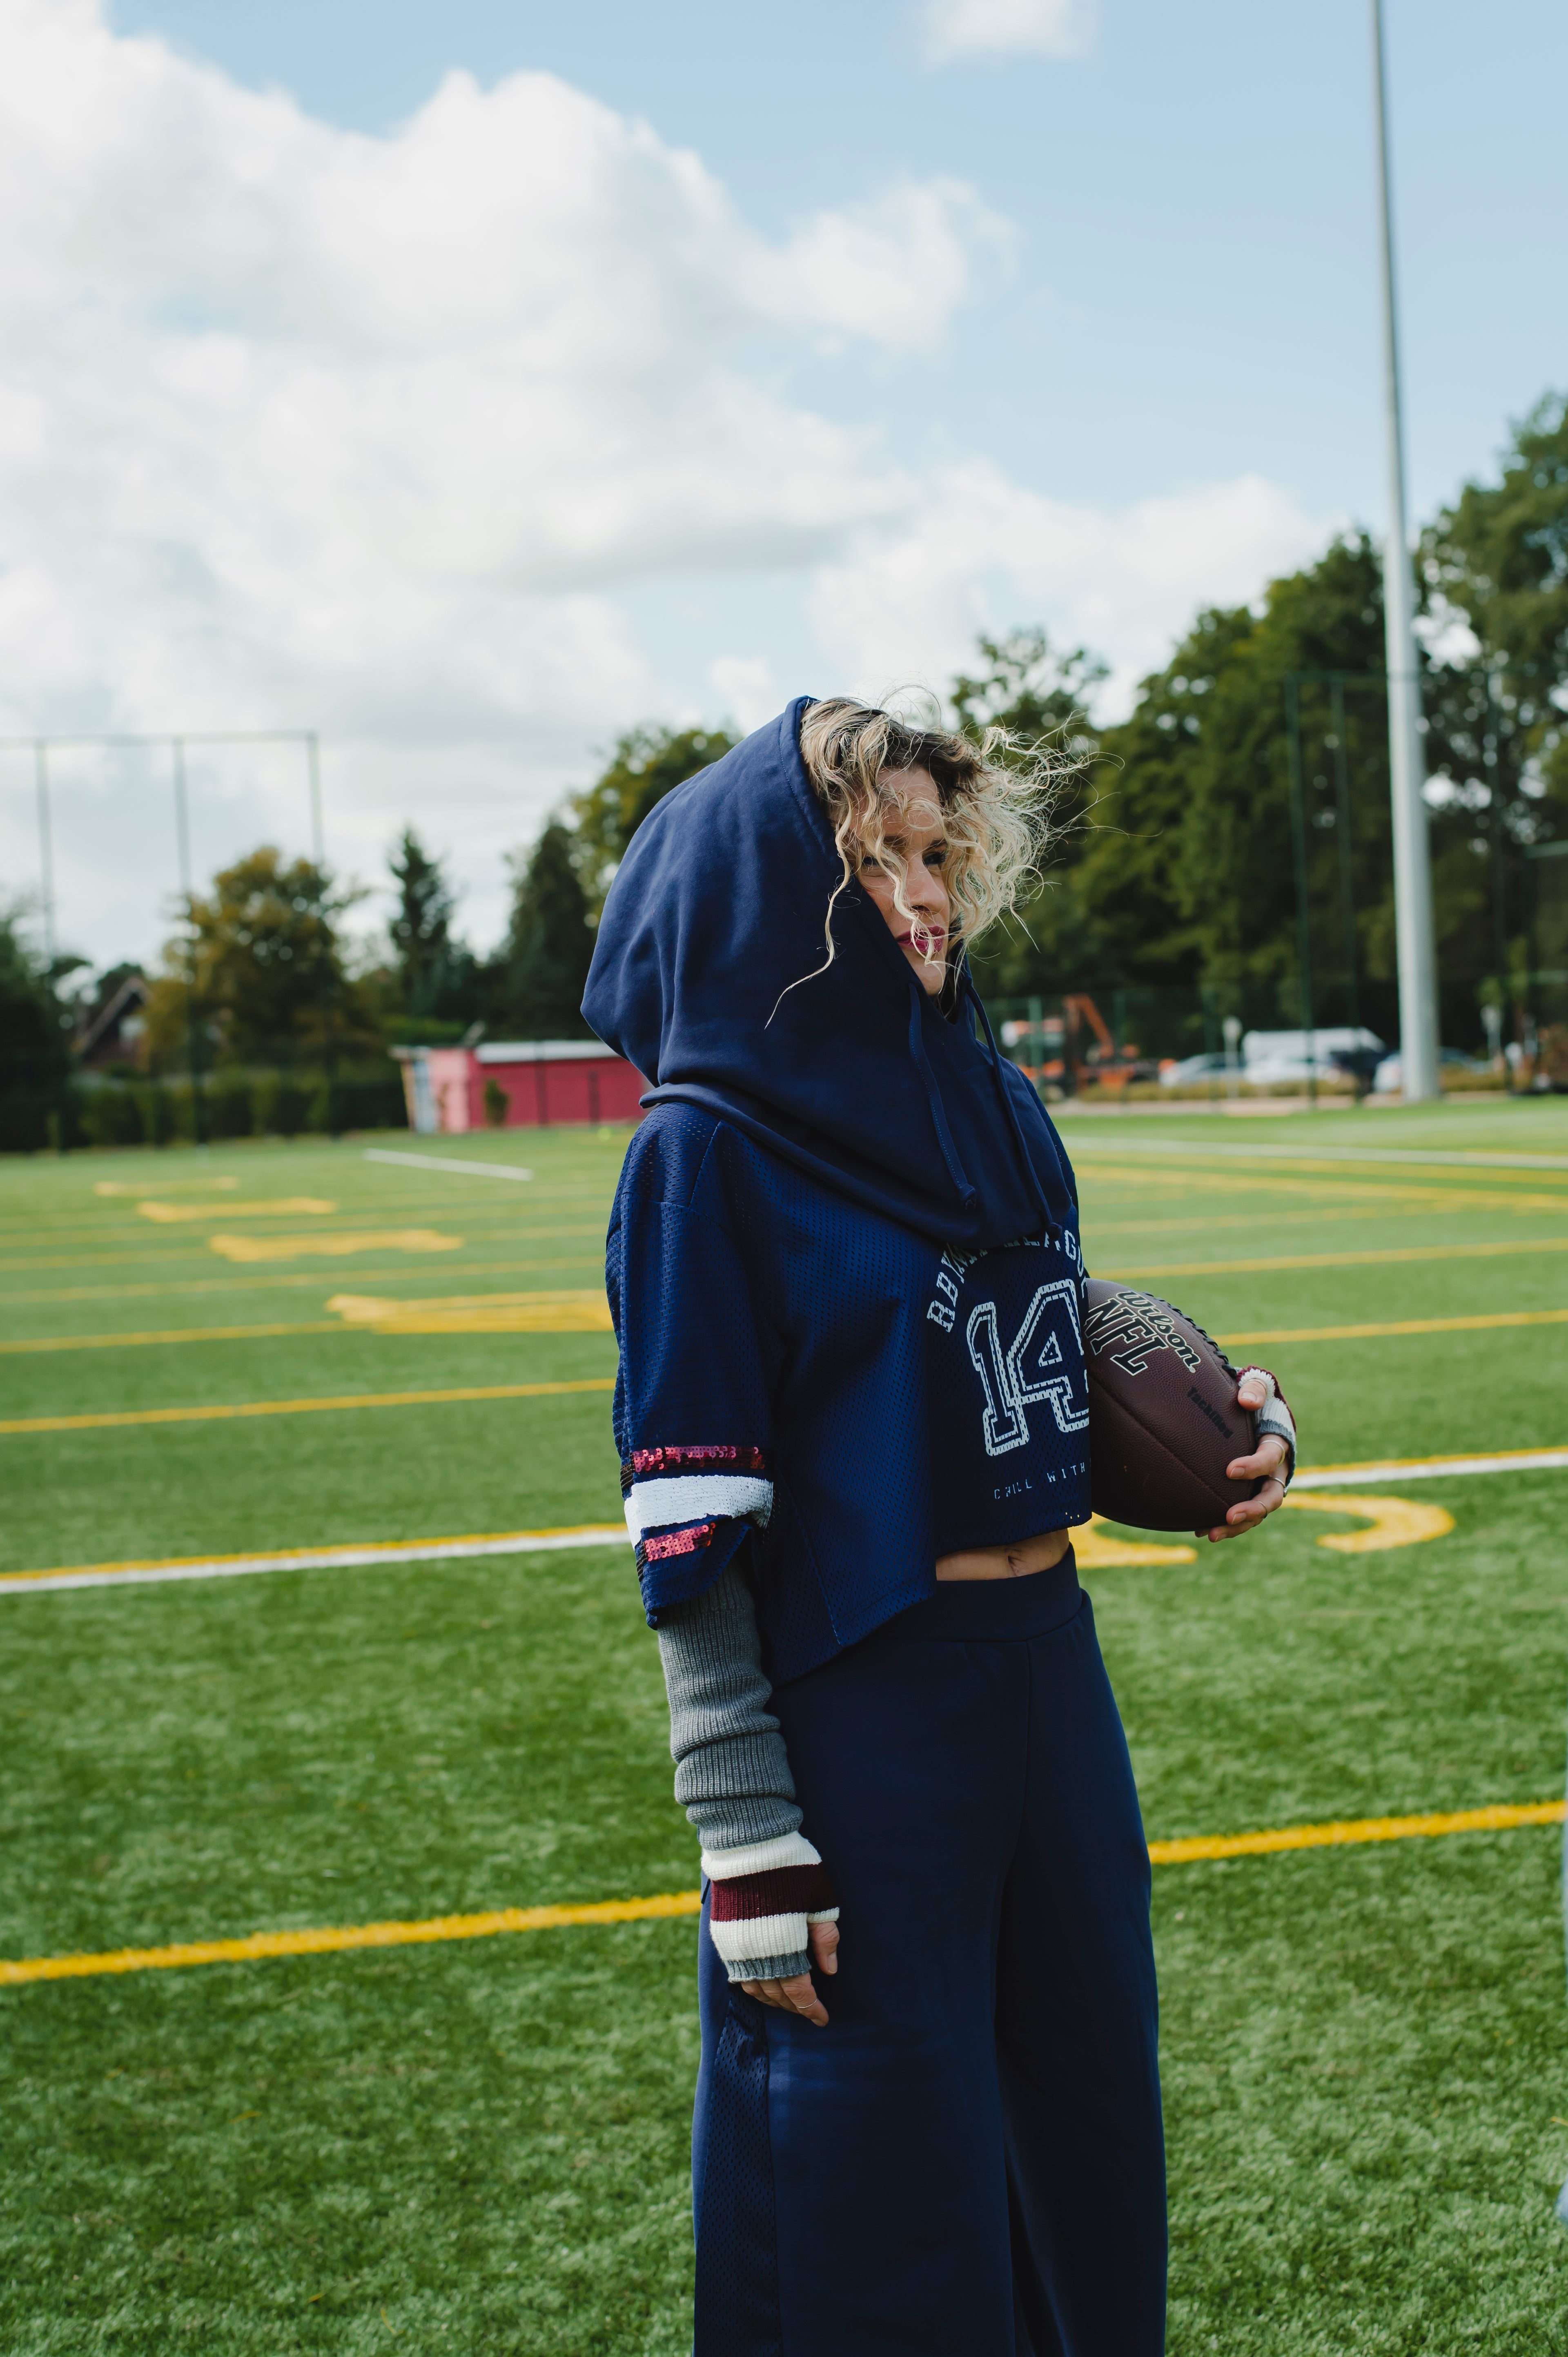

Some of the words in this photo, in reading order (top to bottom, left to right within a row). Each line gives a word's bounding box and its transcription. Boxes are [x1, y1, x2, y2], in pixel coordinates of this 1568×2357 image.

[966, 1279, 1089, 1457] 14
[1083, 1298, 1169, 1376] NFL
[1116, 1290, 1201, 1369] Wilson
[1047, 1462, 1086, 1483] WITH
